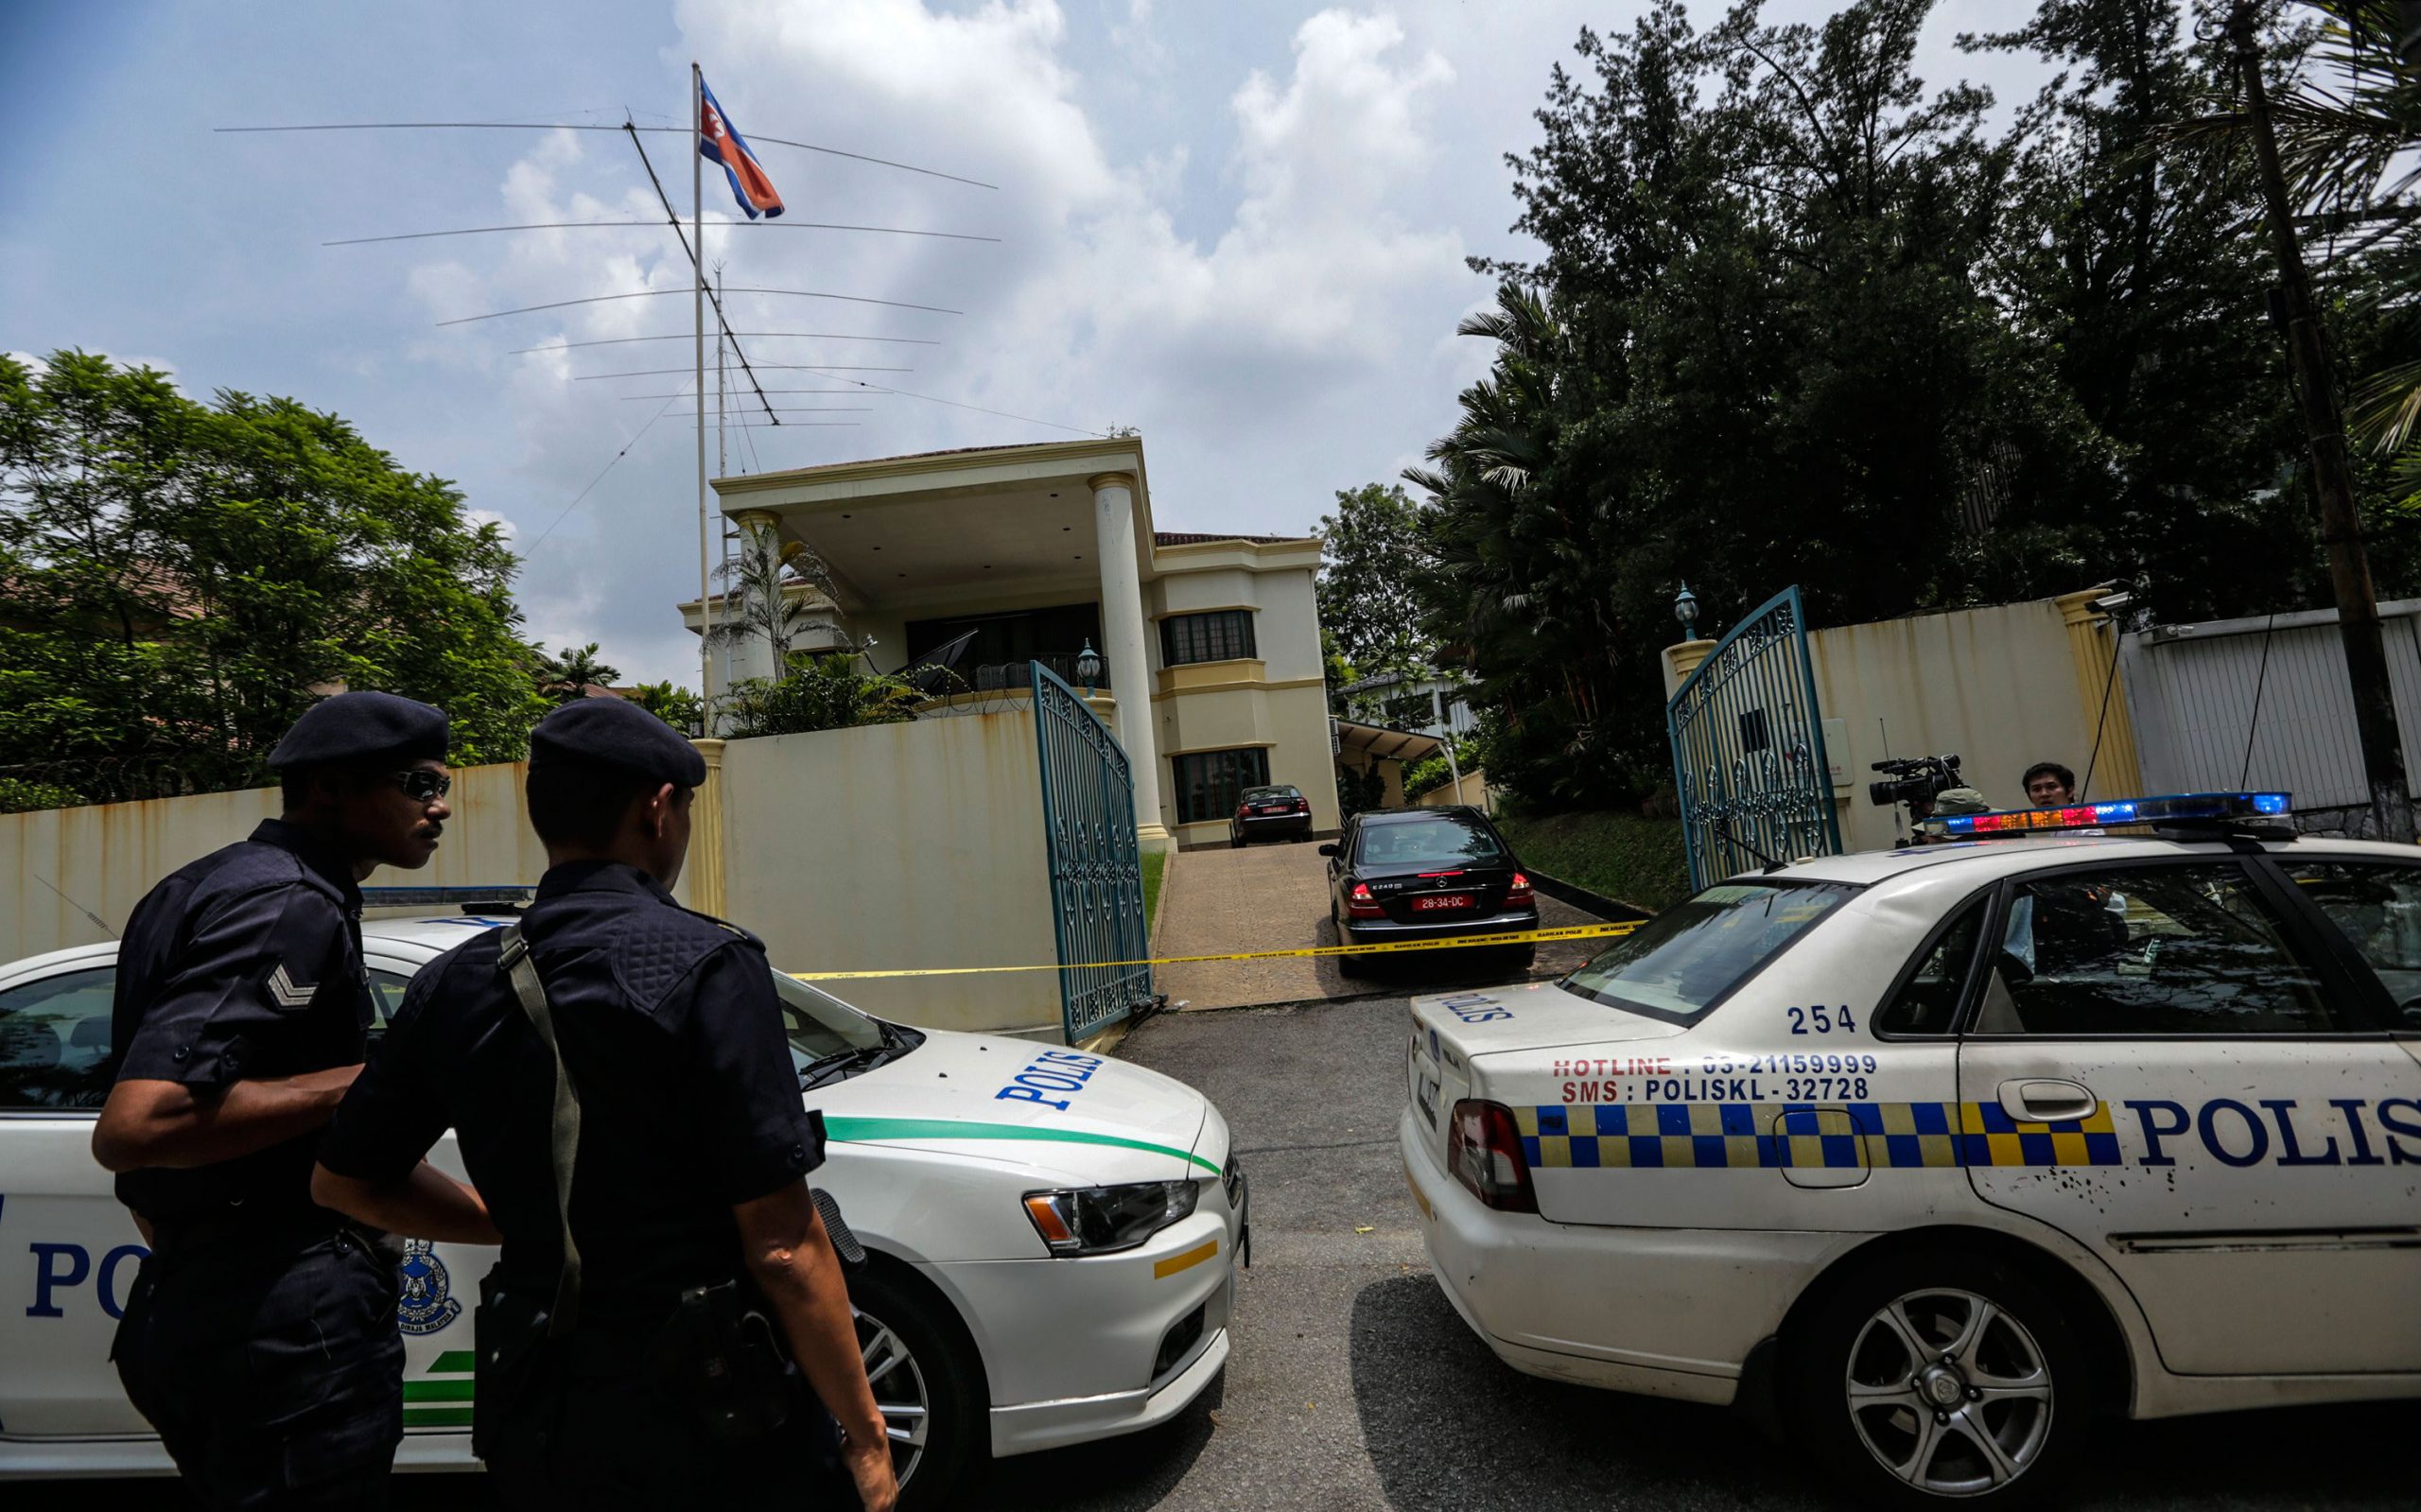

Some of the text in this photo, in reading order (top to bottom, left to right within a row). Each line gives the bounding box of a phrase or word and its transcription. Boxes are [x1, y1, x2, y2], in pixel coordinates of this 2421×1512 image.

[1421, 896, 1464, 909] 28-34-DC
[1435, 993, 1515, 1023] POLIS
[1787, 1005, 1856, 1034] 254
[1553, 1057, 1672, 1077] HOTLINE
[1702, 1054, 1877, 1074] 03-21159999
[994, 1051, 1105, 1112] POLIS
[1561, 1080, 1618, 1104] SMS
[2123, 1098, 2421, 1167] POLIS
